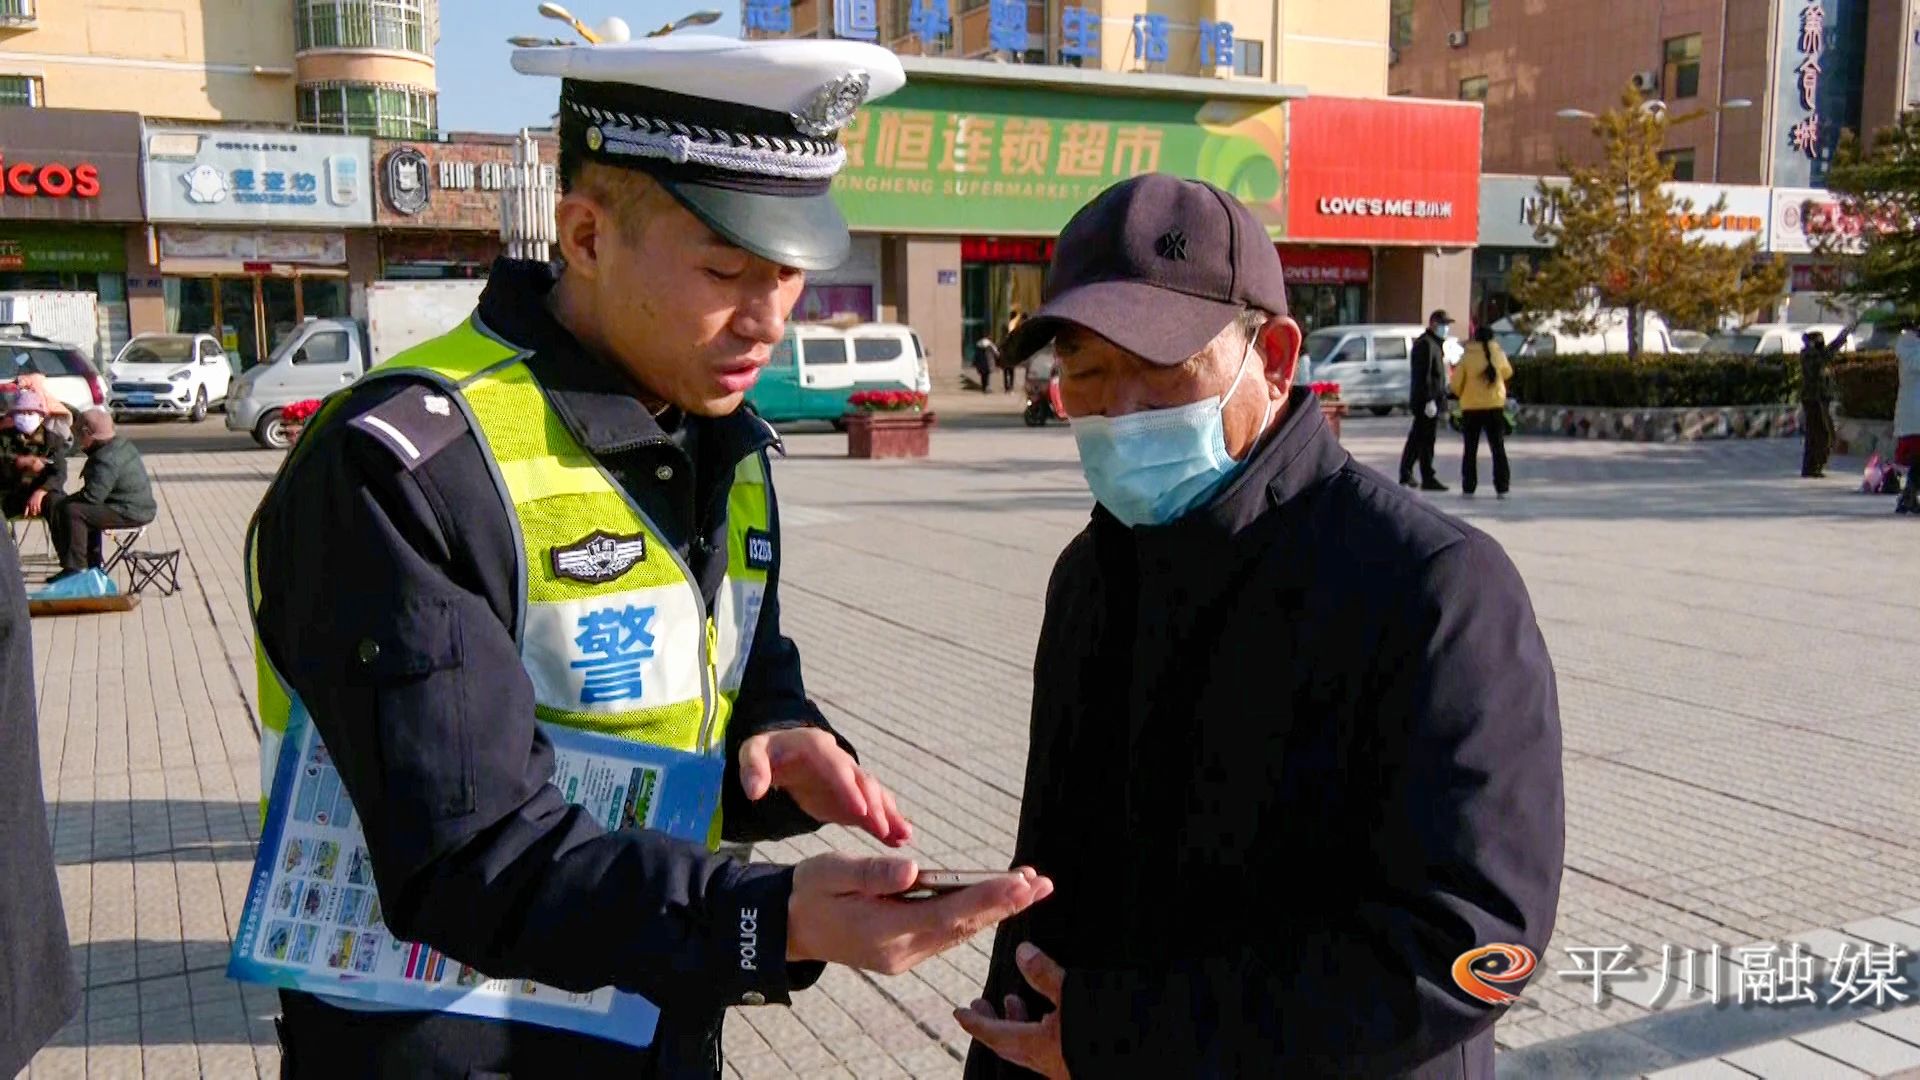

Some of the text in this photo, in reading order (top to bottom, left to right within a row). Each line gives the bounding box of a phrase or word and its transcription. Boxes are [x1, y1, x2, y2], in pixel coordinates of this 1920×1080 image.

[832, 174, 934, 195] ONGHENG
[943, 179, 1079, 199] SUPERMARKET
[1318, 196, 1384, 216] LOVE'S
[1385, 199, 1413, 217] ME
[570, 604, 656, 703] 警
[740, 907, 758, 971] POLICE
